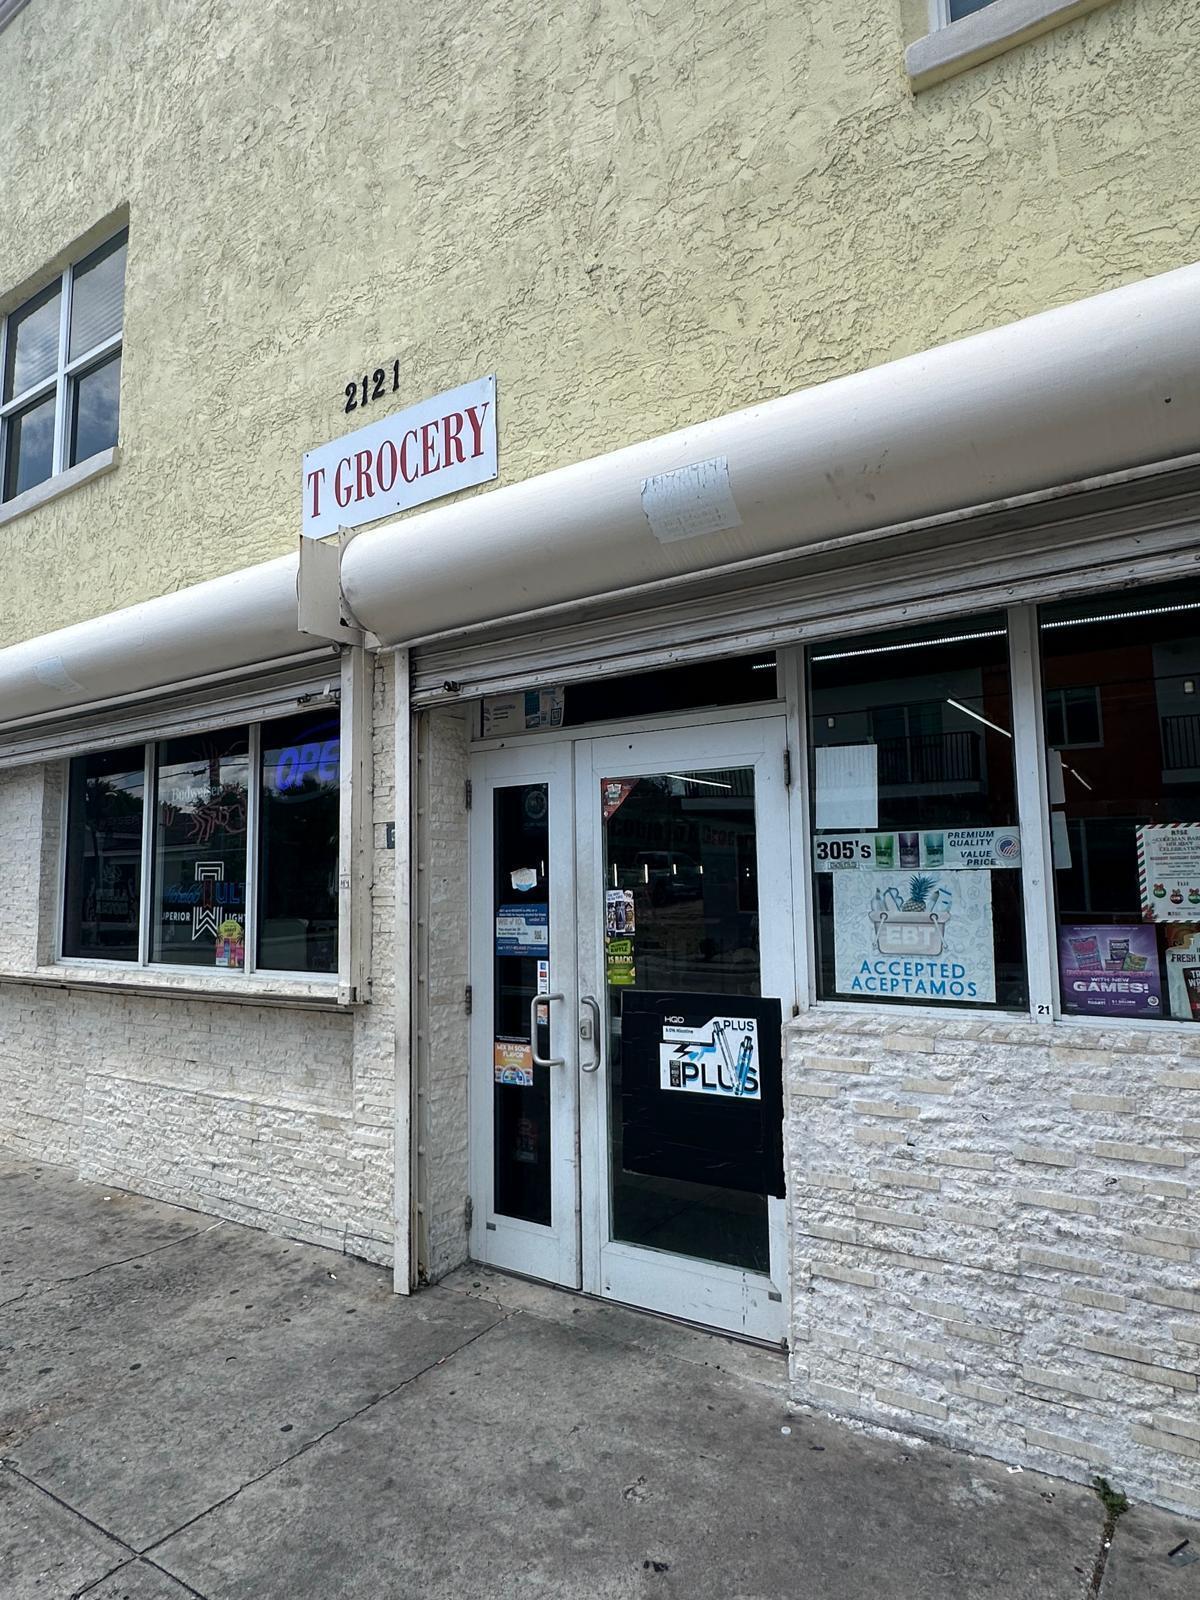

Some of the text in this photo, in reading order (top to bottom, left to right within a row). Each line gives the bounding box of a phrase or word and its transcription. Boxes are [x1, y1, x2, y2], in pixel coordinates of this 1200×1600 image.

[344, 359, 400, 414] 2121
[307, 401, 490, 519] T GROCERY
[276, 738, 340, 791] OPE
[947, 830, 996, 839] PREMIUM
[949, 838, 993, 848] QUALITY
[816, 839, 873, 860] 305's
[960, 850, 993, 858] VALUE
[966, 858, 998, 867] PRICE
[162, 911, 191, 922] UPERIOR
[885, 925, 936, 946] EBT
[1171, 953, 1197, 963] FRESH
[860, 959, 966, 979] ACCEPTED
[851, 976, 977, 997] ACEPTAMOS
[1073, 981, 1149, 994] GAMES!
[1037, 1005, 1051, 1015] 21
[723, 1020, 755, 1032] PLUS
